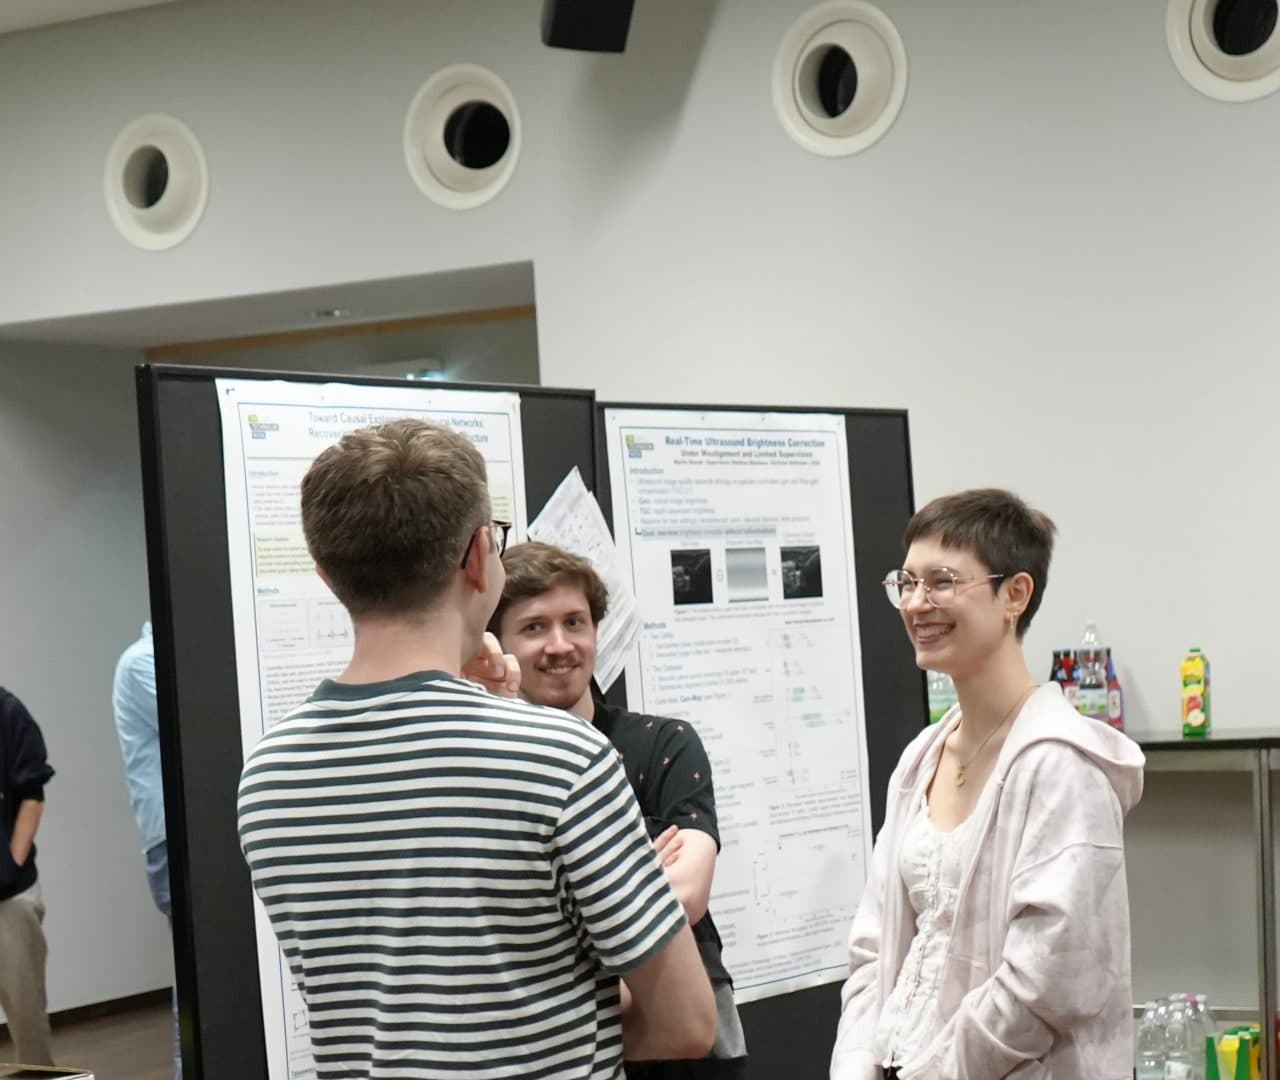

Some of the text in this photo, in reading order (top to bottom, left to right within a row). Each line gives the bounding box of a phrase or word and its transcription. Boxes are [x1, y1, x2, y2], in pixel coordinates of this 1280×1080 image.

[665, 436, 825, 450] Real-Time Ultrasound Brightness Correction
